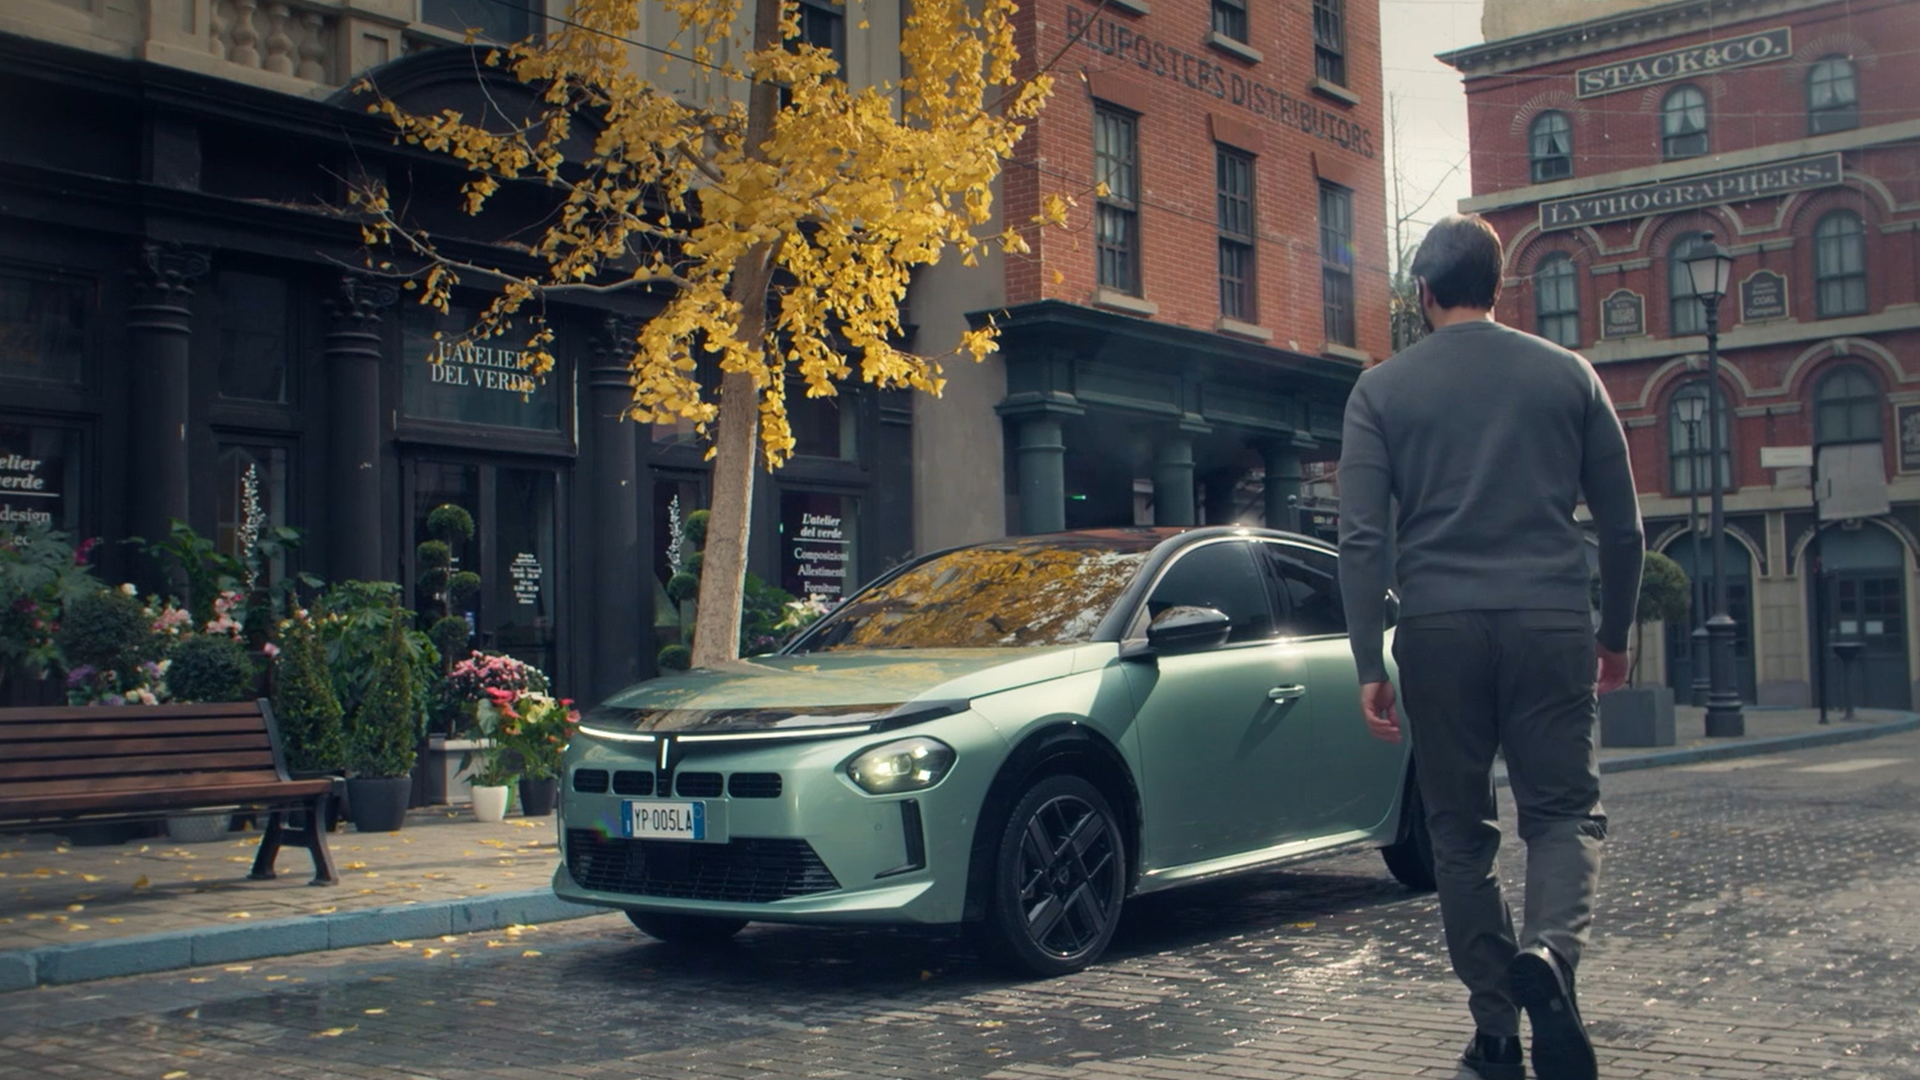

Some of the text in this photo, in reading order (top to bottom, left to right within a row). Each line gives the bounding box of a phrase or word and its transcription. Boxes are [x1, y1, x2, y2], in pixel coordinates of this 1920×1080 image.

[1584, 36, 1783, 92] STACK&CO.
[1230, 73, 1374, 159] DISTRIBUTORS
[1550, 164, 1832, 223] LYTHOGRAPHERS.
[431, 363, 469, 386] DEL
[0, 473, 45, 490] erde
[802, 513, 842, 527] L'atelier
[800, 526, 843, 539] del verde
[793, 547, 849, 563] Composizioni
[797, 564, 846, 577] Allestimenti
[804, 581, 841, 594] Forniture
